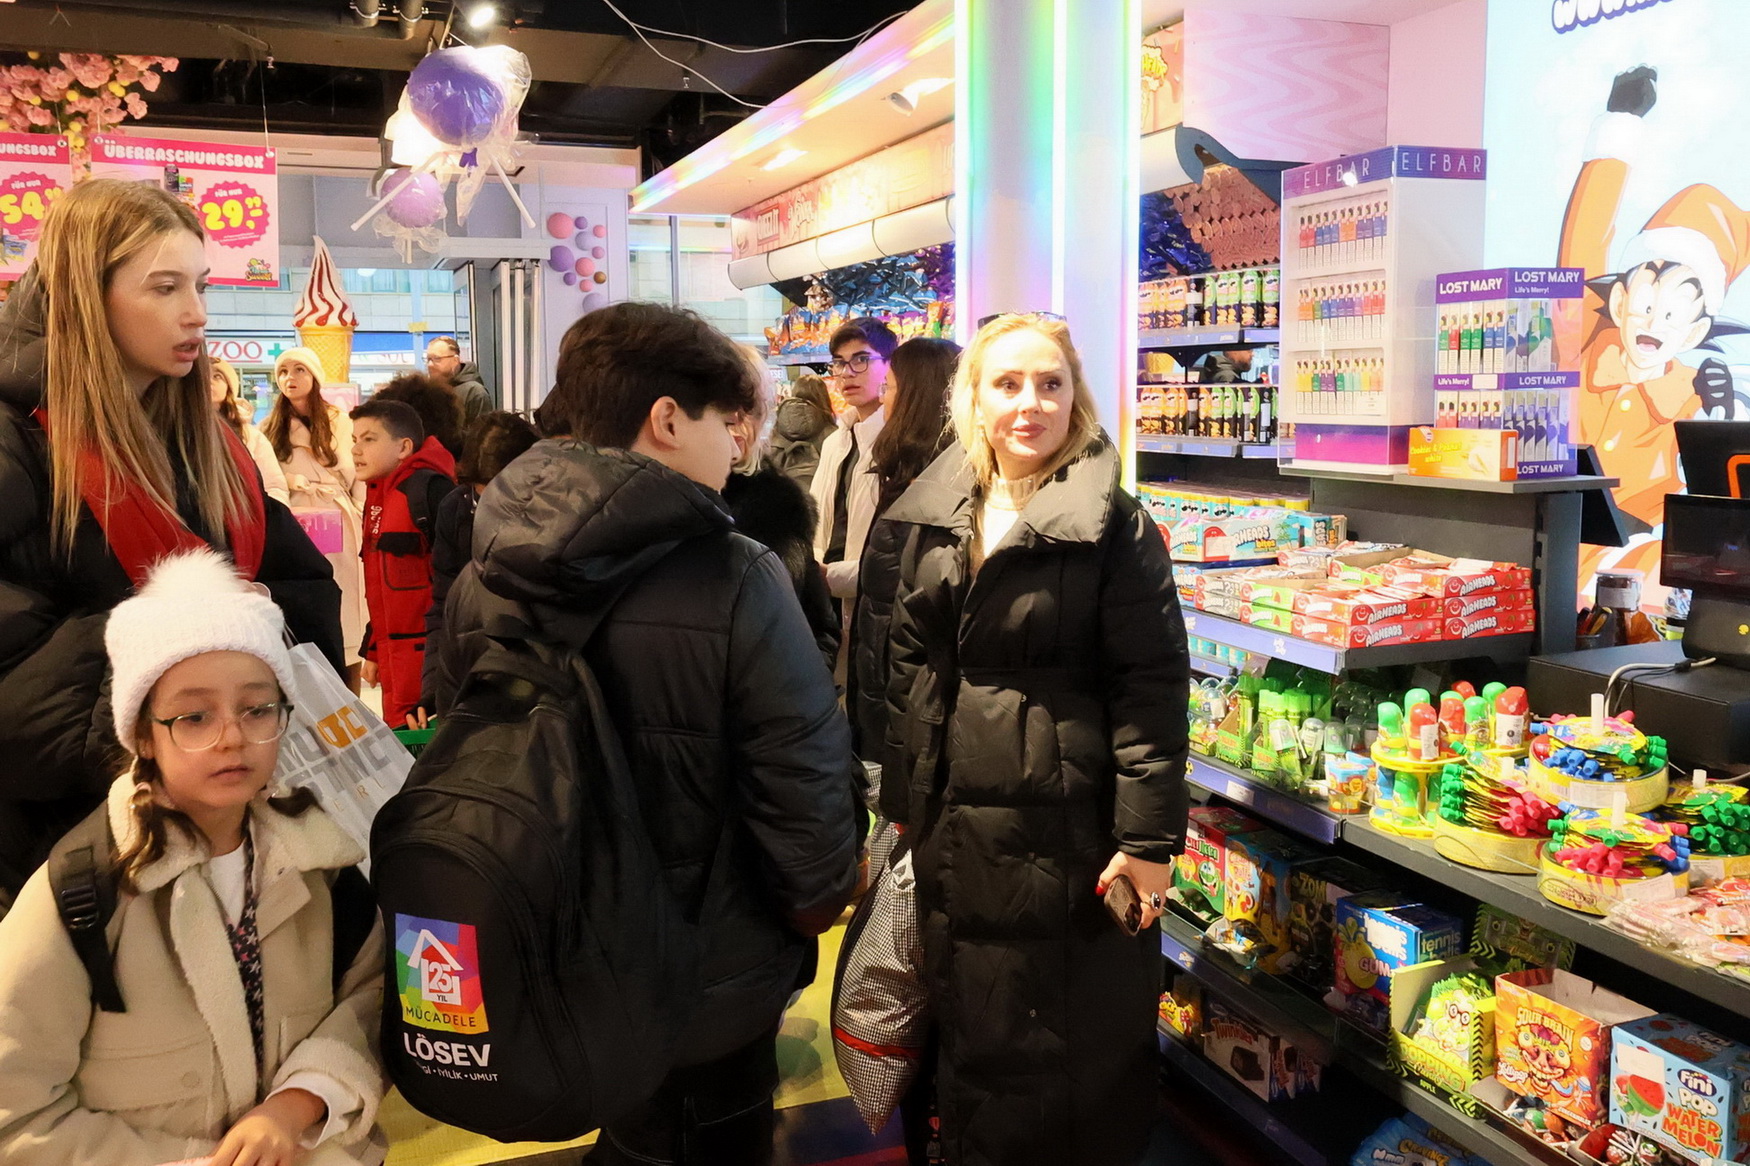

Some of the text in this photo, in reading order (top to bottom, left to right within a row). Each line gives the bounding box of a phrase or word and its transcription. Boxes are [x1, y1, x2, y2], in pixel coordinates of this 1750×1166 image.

[104, 140, 264, 169] ÜBERRASCHUNGSBOX
[1401, 152, 1481, 173] ELFBAR
[1440, 277, 1503, 295] LOST MARY
[1515, 271, 1580, 283] LOST MARY
[207, 341, 262, 358] ZOO
[1519, 375, 1567, 386] LOST MARY
[1517, 463, 1564, 475] LOST MARY
[1460, 575, 1495, 596] AIRHEADS
[1367, 603, 1407, 624] AIRHEADS
[1461, 596, 1497, 617] AIRHEADS
[1366, 624, 1403, 647] AIRHEADS
[1462, 616, 1497, 639] AIRHEADS
[1421, 929, 1461, 954] tennis
[428, 962, 453, 993] 25
[1359, 957, 1391, 977] GUM
[436, 994, 448, 1003] YIL
[406, 1004, 476, 1028] MÜCADELE
[1516, 1007, 1542, 1027] SOUR
[403, 1031, 491, 1067] LÖSEV
[469, 1072, 498, 1082] UMUT
[1680, 1071, 1714, 1096] Fini
[1678, 1088, 1718, 1116] POP
[1667, 1102, 1720, 1138] WATER
[1662, 1116, 1722, 1159] MELON
